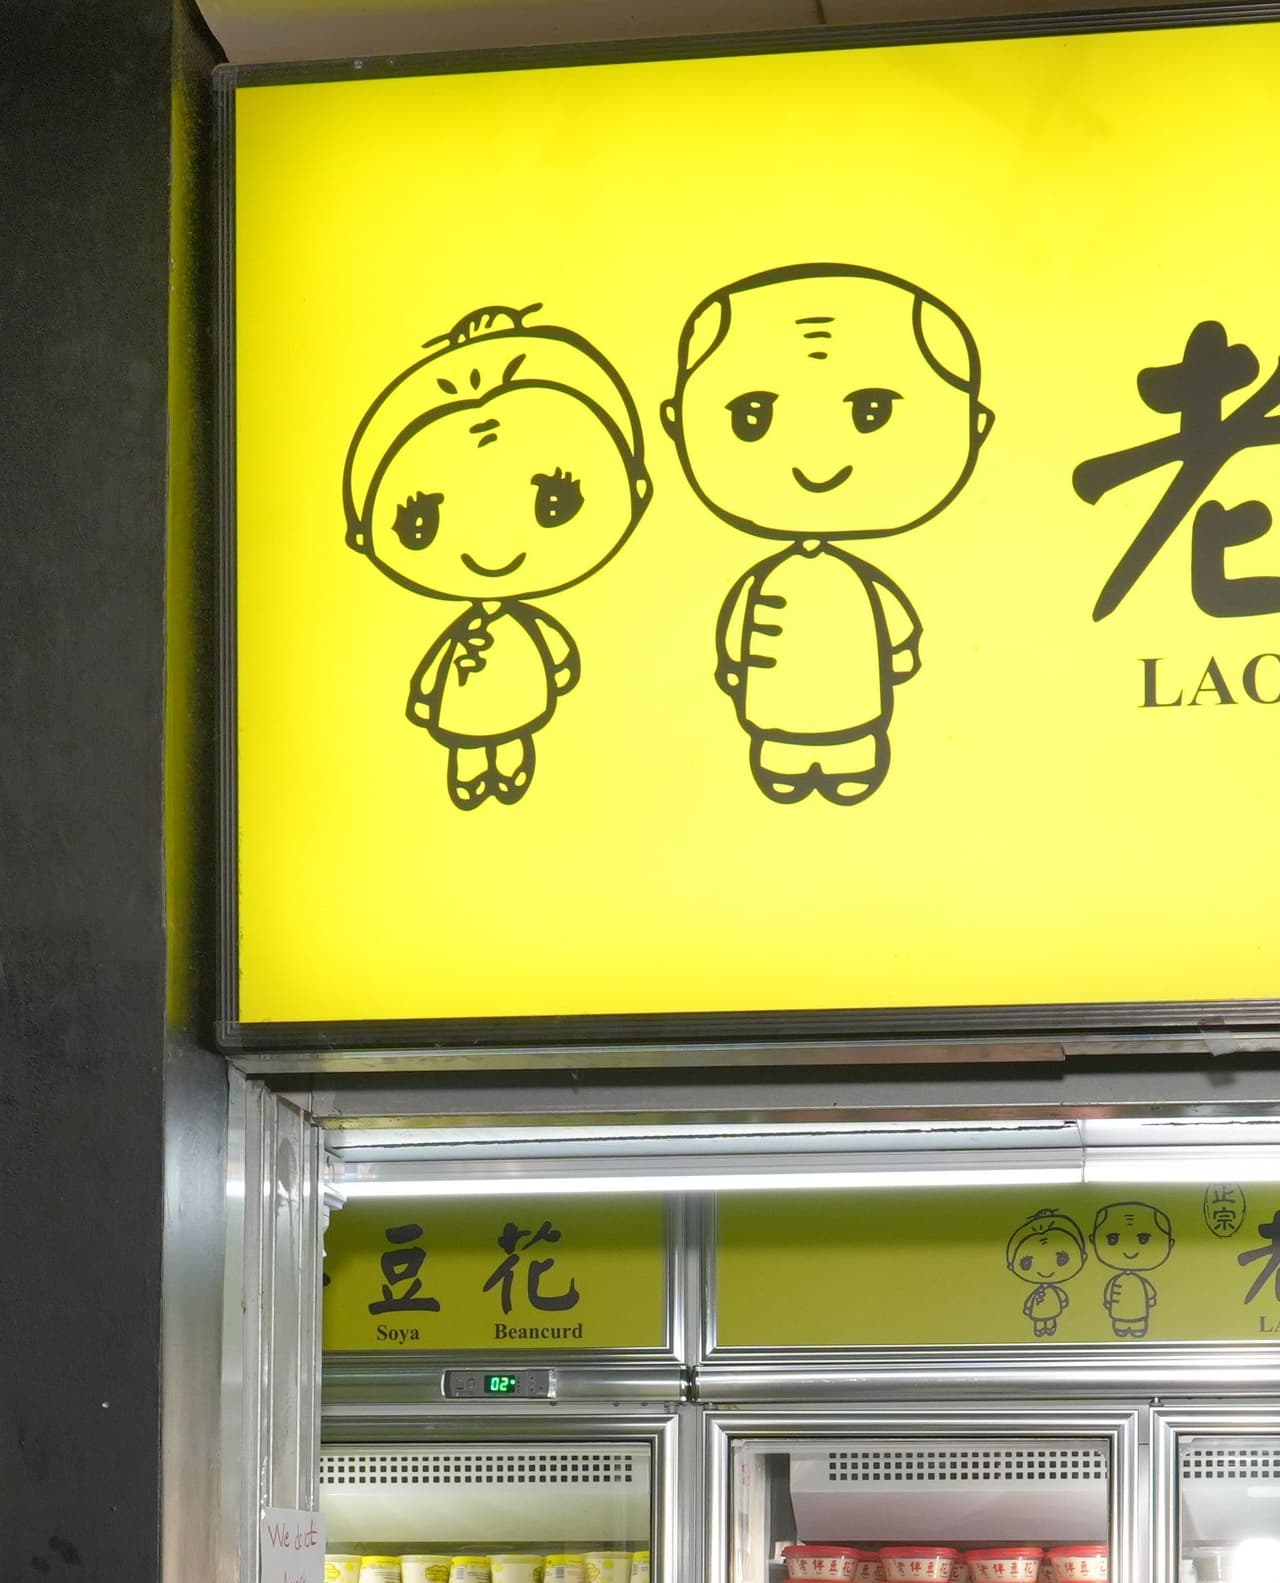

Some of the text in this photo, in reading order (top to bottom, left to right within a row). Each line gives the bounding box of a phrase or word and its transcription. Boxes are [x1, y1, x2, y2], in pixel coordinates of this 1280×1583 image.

[377, 1323, 582, 1344] Soya Beancurd
[268, 1522, 289, 1548] We
